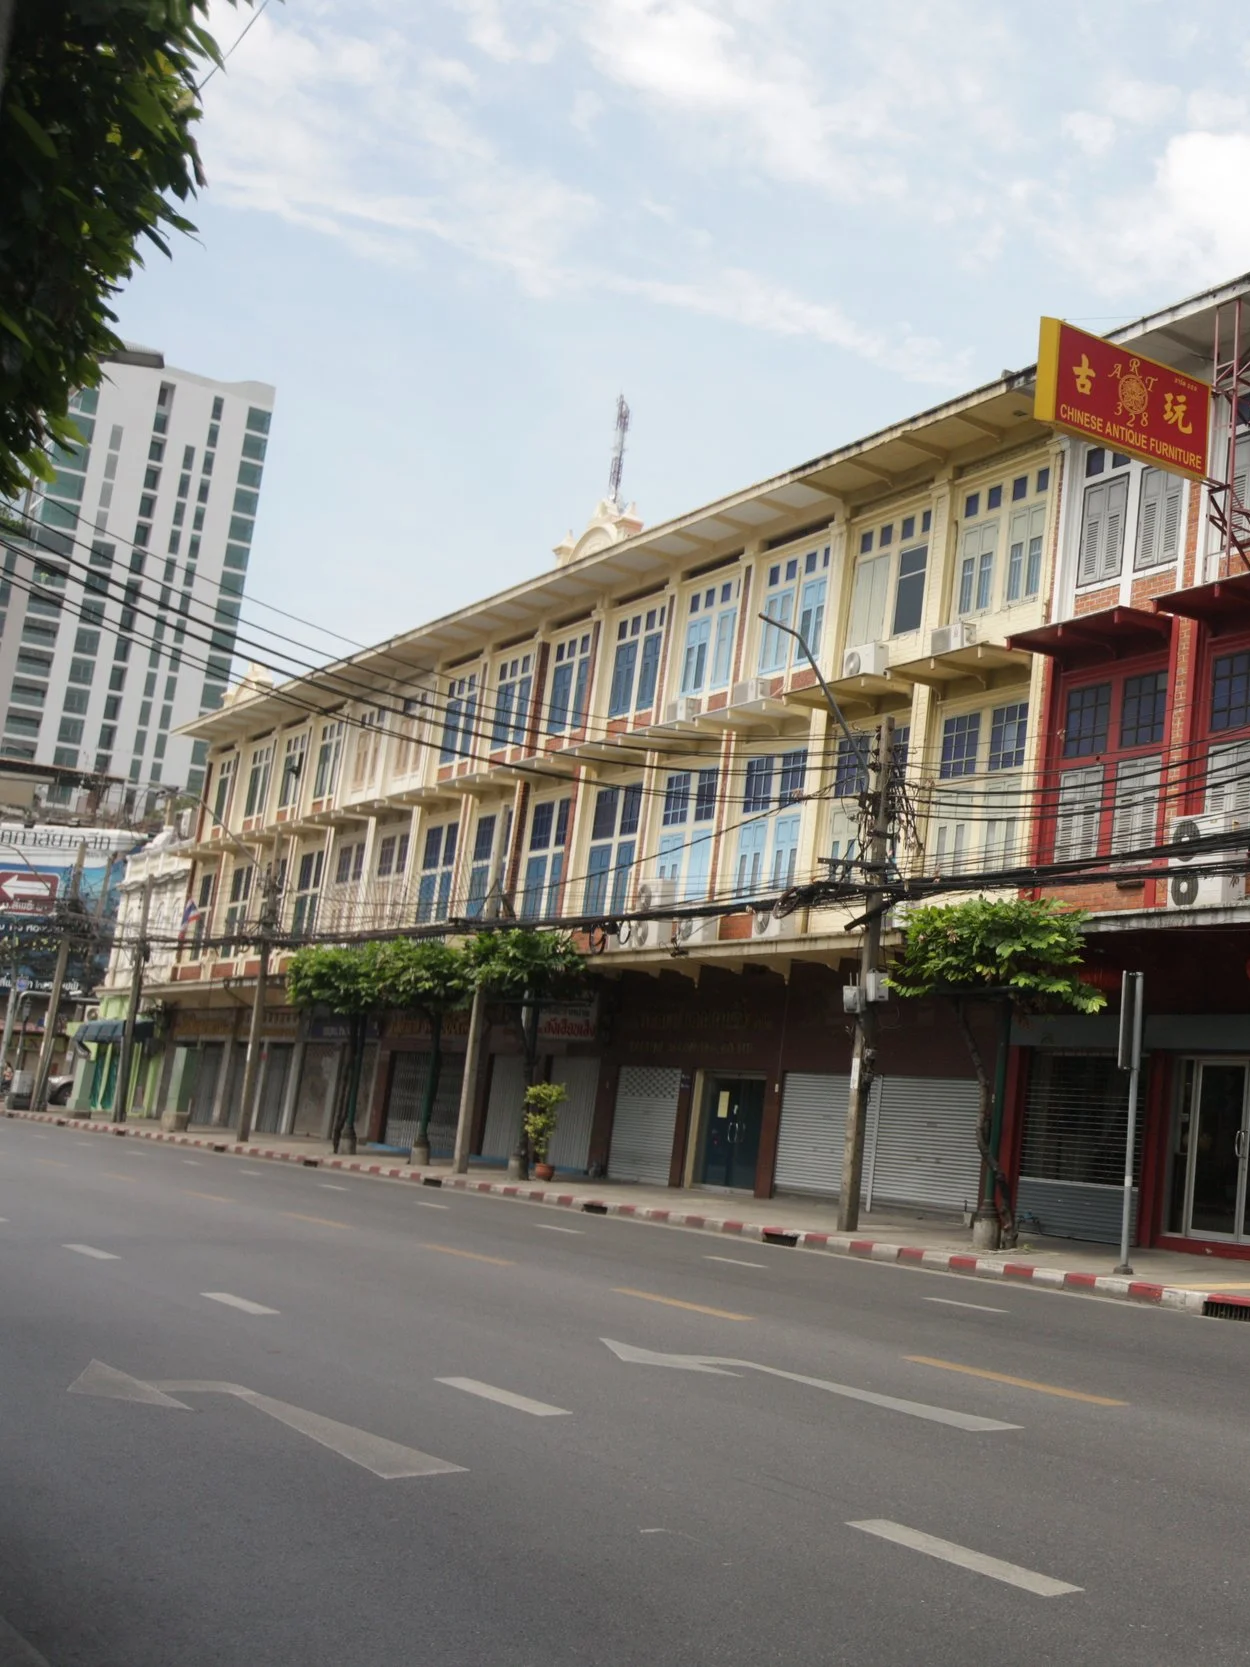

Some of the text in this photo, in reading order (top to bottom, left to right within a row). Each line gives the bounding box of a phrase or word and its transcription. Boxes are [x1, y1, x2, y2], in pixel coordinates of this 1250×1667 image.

[1072, 353, 1193, 435] 古 玩
[1108, 357, 1159, 393] ART
[1060, 404, 1203, 470] CHINESE ANTIQUE FURNITURE
[1114, 401, 1149, 427] 328
